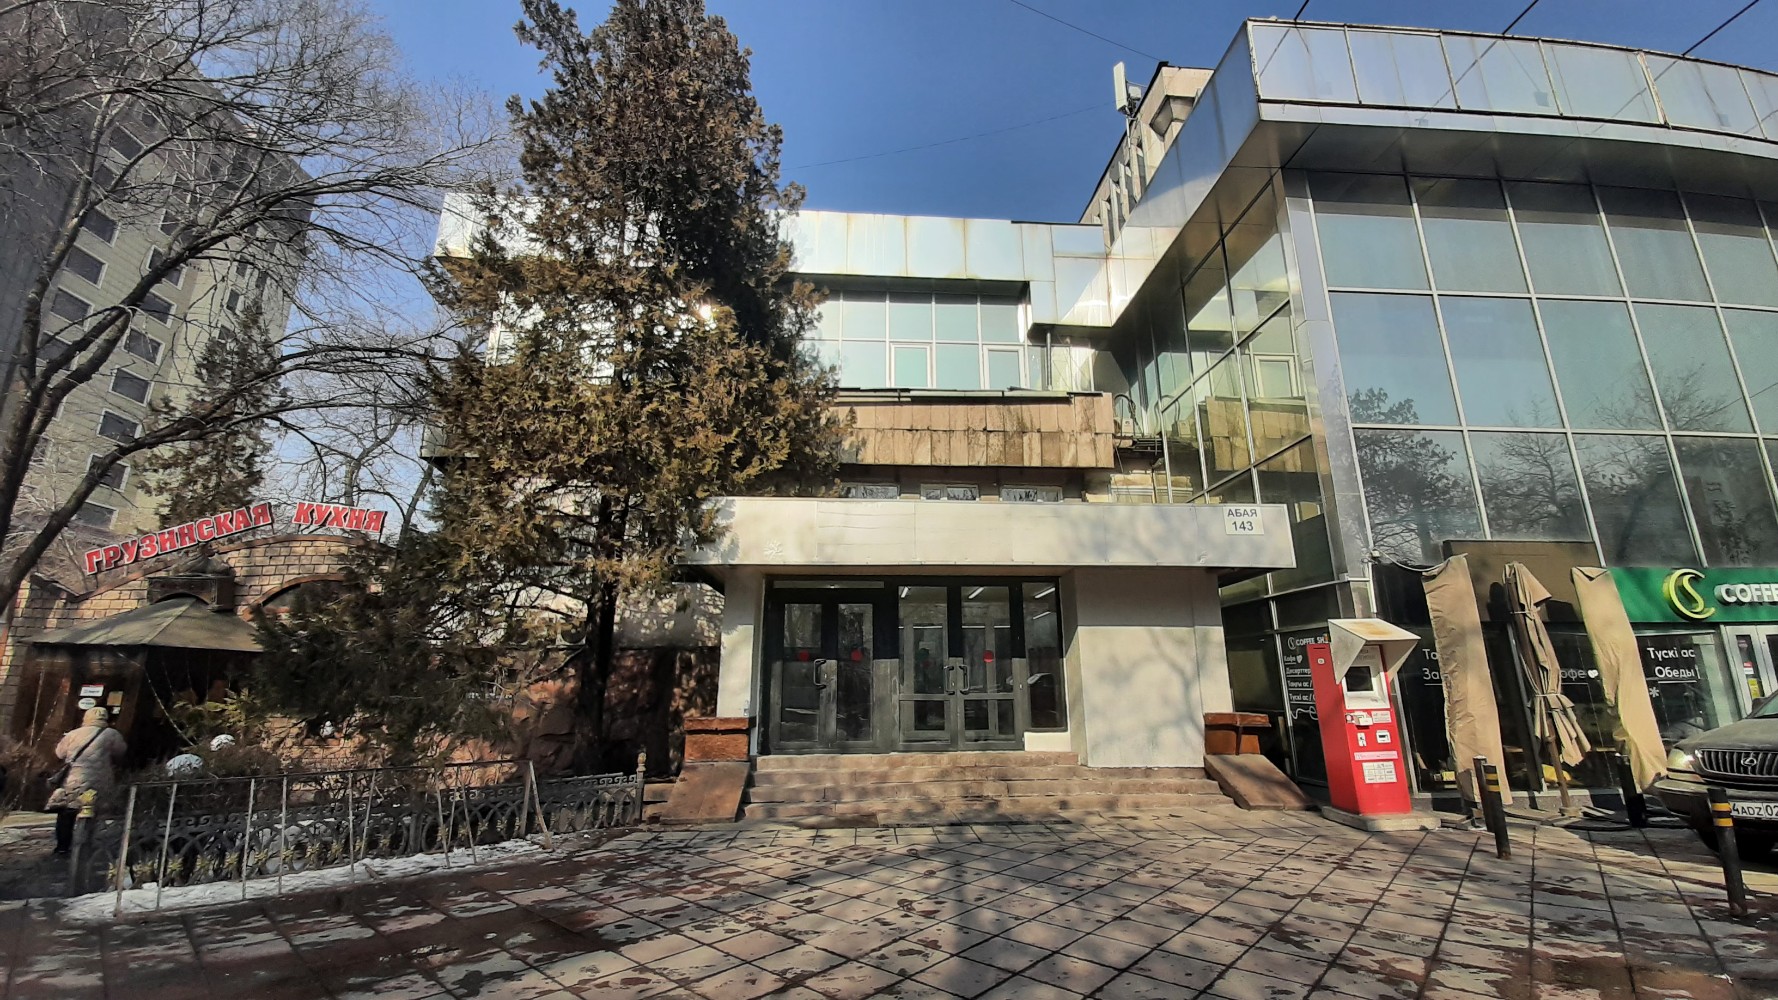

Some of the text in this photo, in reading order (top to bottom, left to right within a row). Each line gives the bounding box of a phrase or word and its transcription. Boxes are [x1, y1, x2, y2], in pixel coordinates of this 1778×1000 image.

[1227, 508, 1258, 518] АБАЯ
[1232, 520, 1254, 531] 143
[85, 502, 386, 575] ГРУЗИНСКАЯ КУХНЯ
[1295, 637, 1316, 646] COFFEE
[1681, 649, 1696, 658] ас
[1560, 668, 1587, 681] офе
[1655, 666, 1695, 678] Обеды
